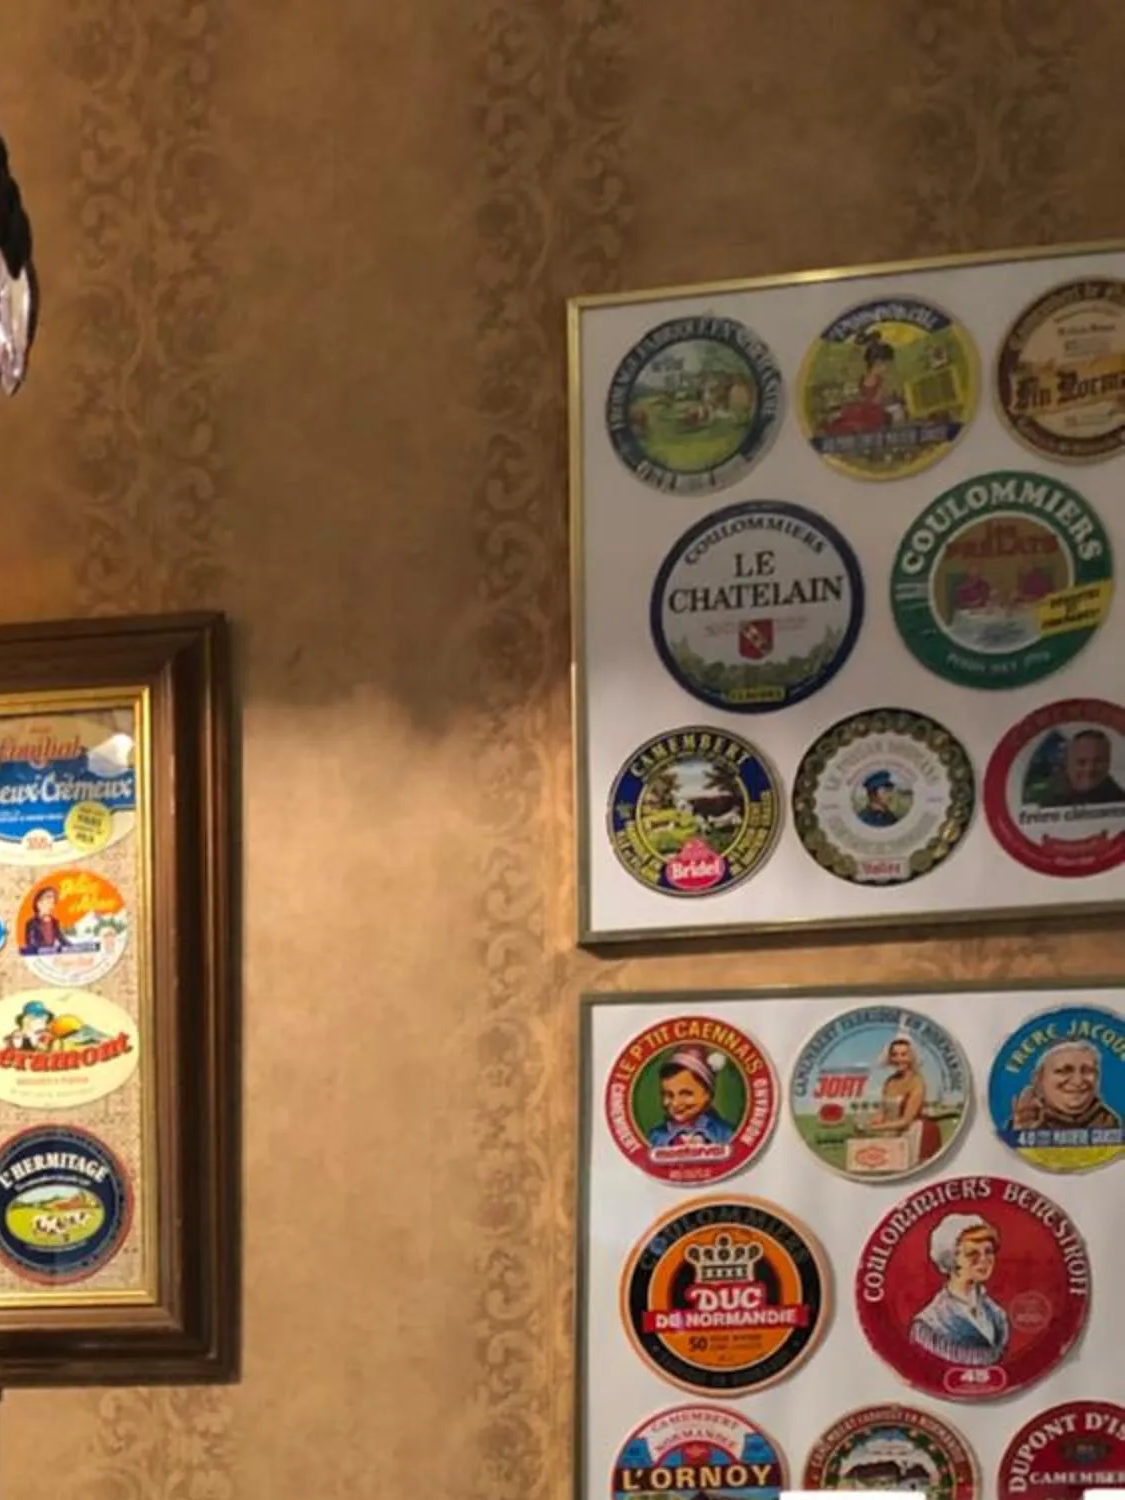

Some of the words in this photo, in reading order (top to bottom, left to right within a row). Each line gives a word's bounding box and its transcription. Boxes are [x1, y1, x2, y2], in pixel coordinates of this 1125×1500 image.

[684, 515, 828, 566] COULOMMIERS
[901, 480, 1103, 574] COULOMMIERS
[734, 550, 775, 578] LE
[668, 576, 844, 614] CHATELAIN
[630, 733, 751, 778] CAMEMBERT
[671, 858, 721, 877] Bridel
[615, 1059, 636, 1081] LE
[674, 1021, 763, 1075] CAENNAIS
[1066, 1018, 1125, 1062] JACQU
[813, 1075, 869, 1098] JORT
[863, 1178, 992, 1303] COULOMMIERS
[690, 1287, 763, 1310] DUC
[655, 1313, 684, 1329] DE
[685, 1308, 796, 1327] NORMANDIE
[688, 1335, 708, 1353] 50
[651, 1411, 738, 1433] CAMEMBERT
[1008, 1414, 1078, 1494] DUPONT
[622, 1463, 772, 1490] L'ORNOY
